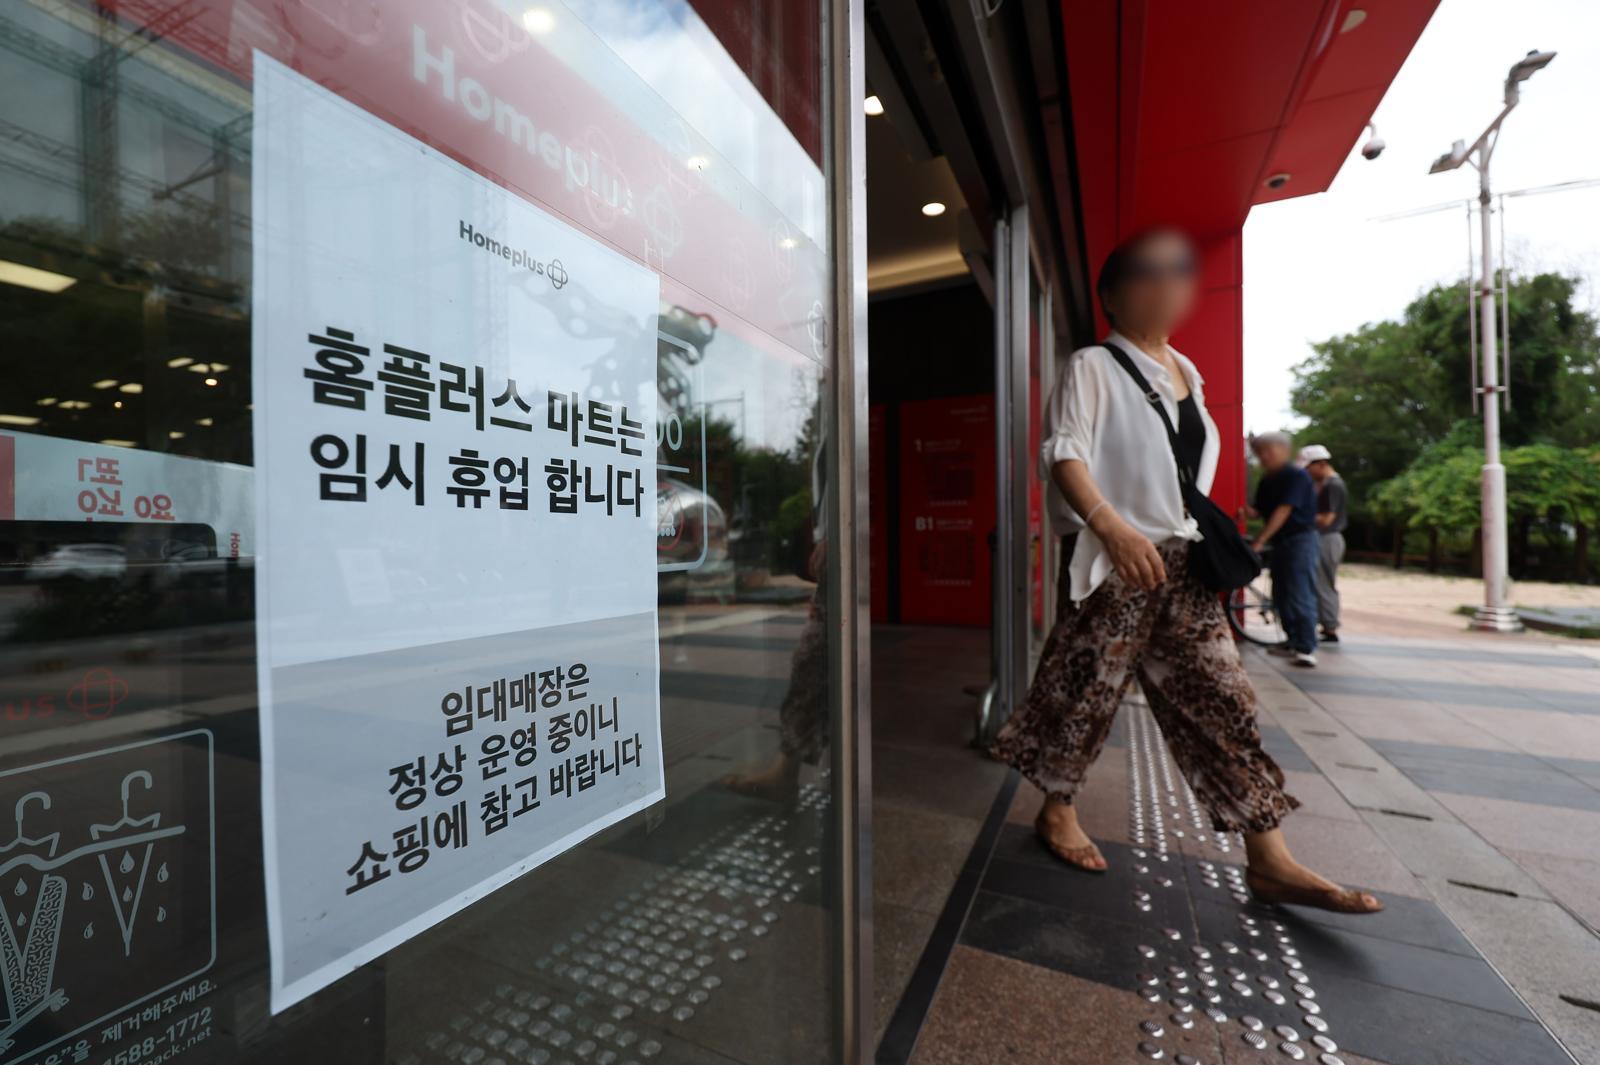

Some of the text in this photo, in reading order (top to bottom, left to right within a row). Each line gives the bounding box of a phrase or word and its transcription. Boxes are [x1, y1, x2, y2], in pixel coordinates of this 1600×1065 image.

[412, 23, 633, 216] Homeplus
[459, 219, 545, 276] Homeplus
[304, 326, 646, 457] 홈플러스 마트는
[310, 434, 645, 517] 임시 휴업 합니다
[915, 517, 934, 531] B1
[440, 662, 590, 738] 임대매장은
[388, 696, 619, 811] 정상 운영 중이니
[345, 733, 643, 896] 쇼핑에 참고 바랍니다
[101, 978, 217, 1043] 제거해주세요.
